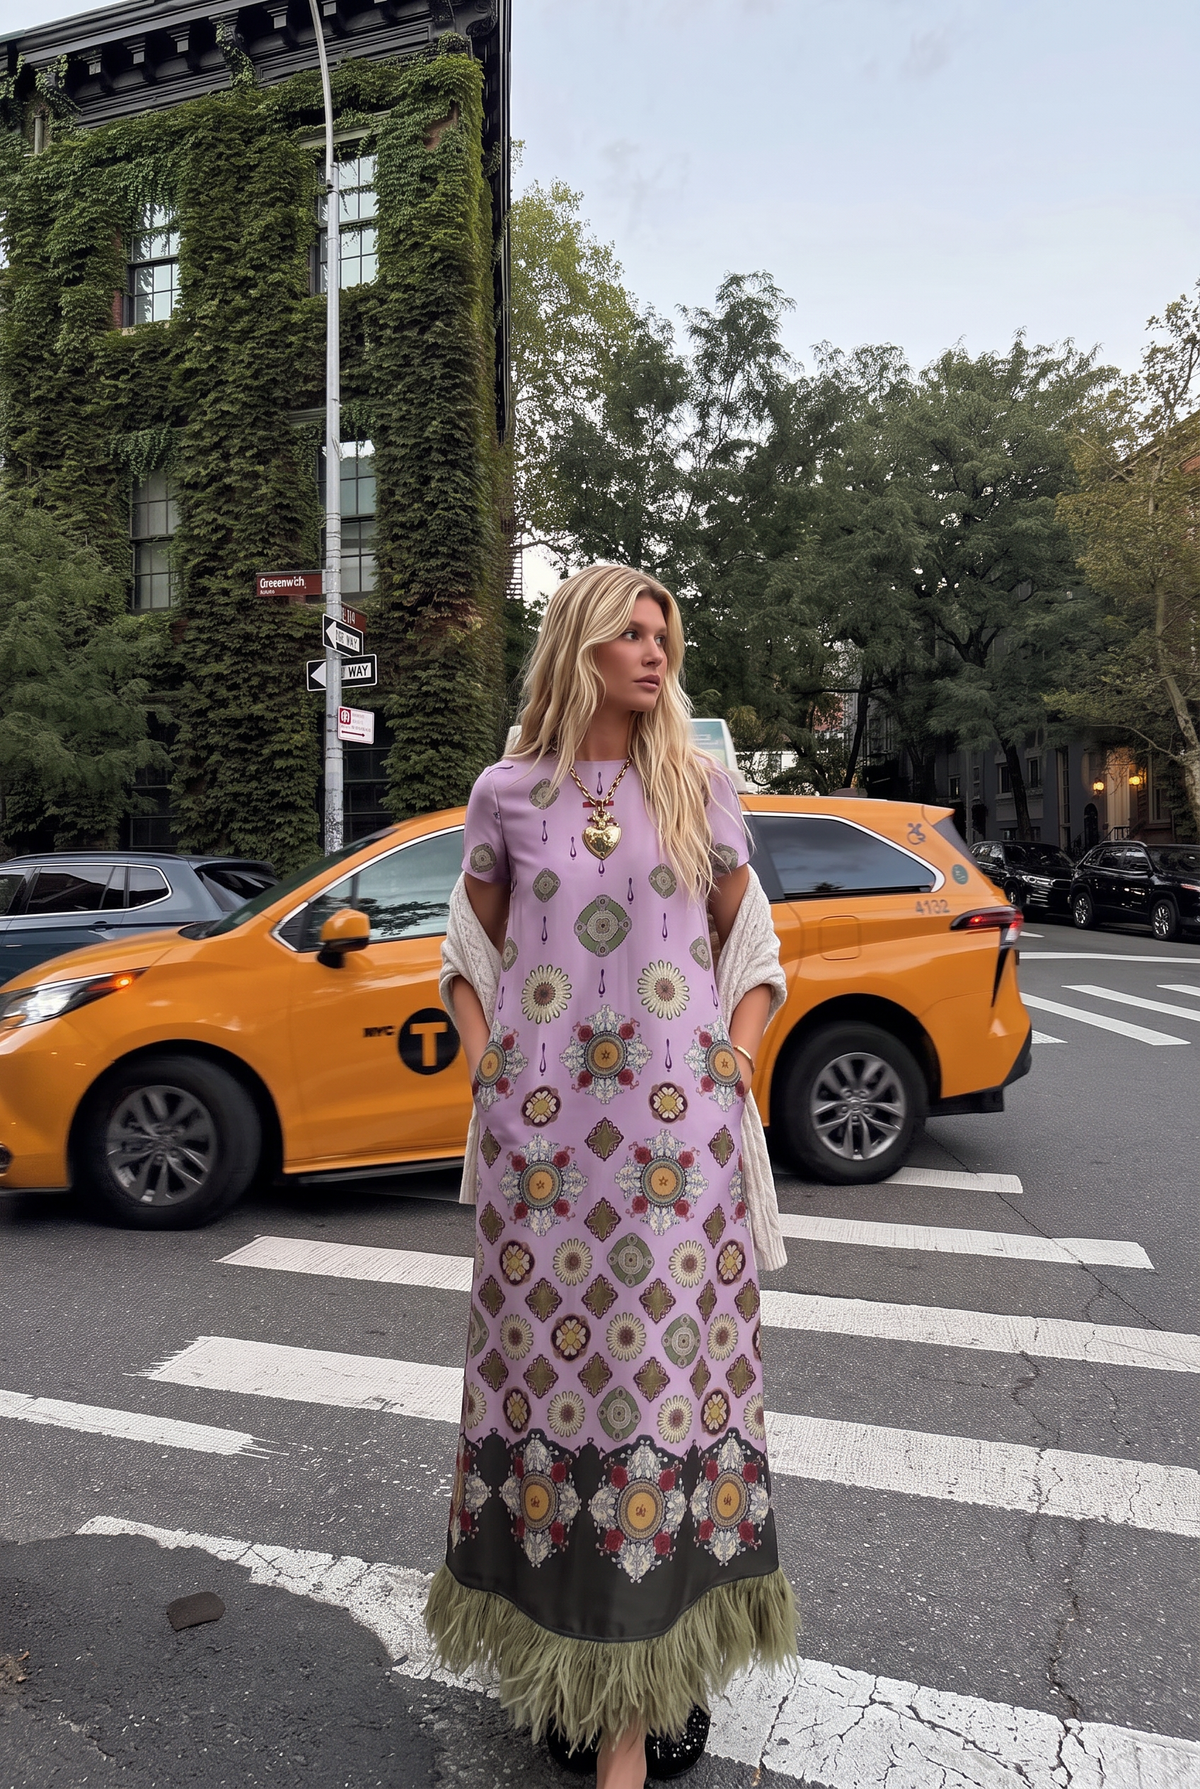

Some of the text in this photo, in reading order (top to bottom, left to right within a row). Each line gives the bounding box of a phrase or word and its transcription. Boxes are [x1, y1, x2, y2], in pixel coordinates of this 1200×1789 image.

[348, 665, 368, 678] WAY
[916, 899, 950, 915] 4132
[364, 1021, 447, 1067] NYC T
